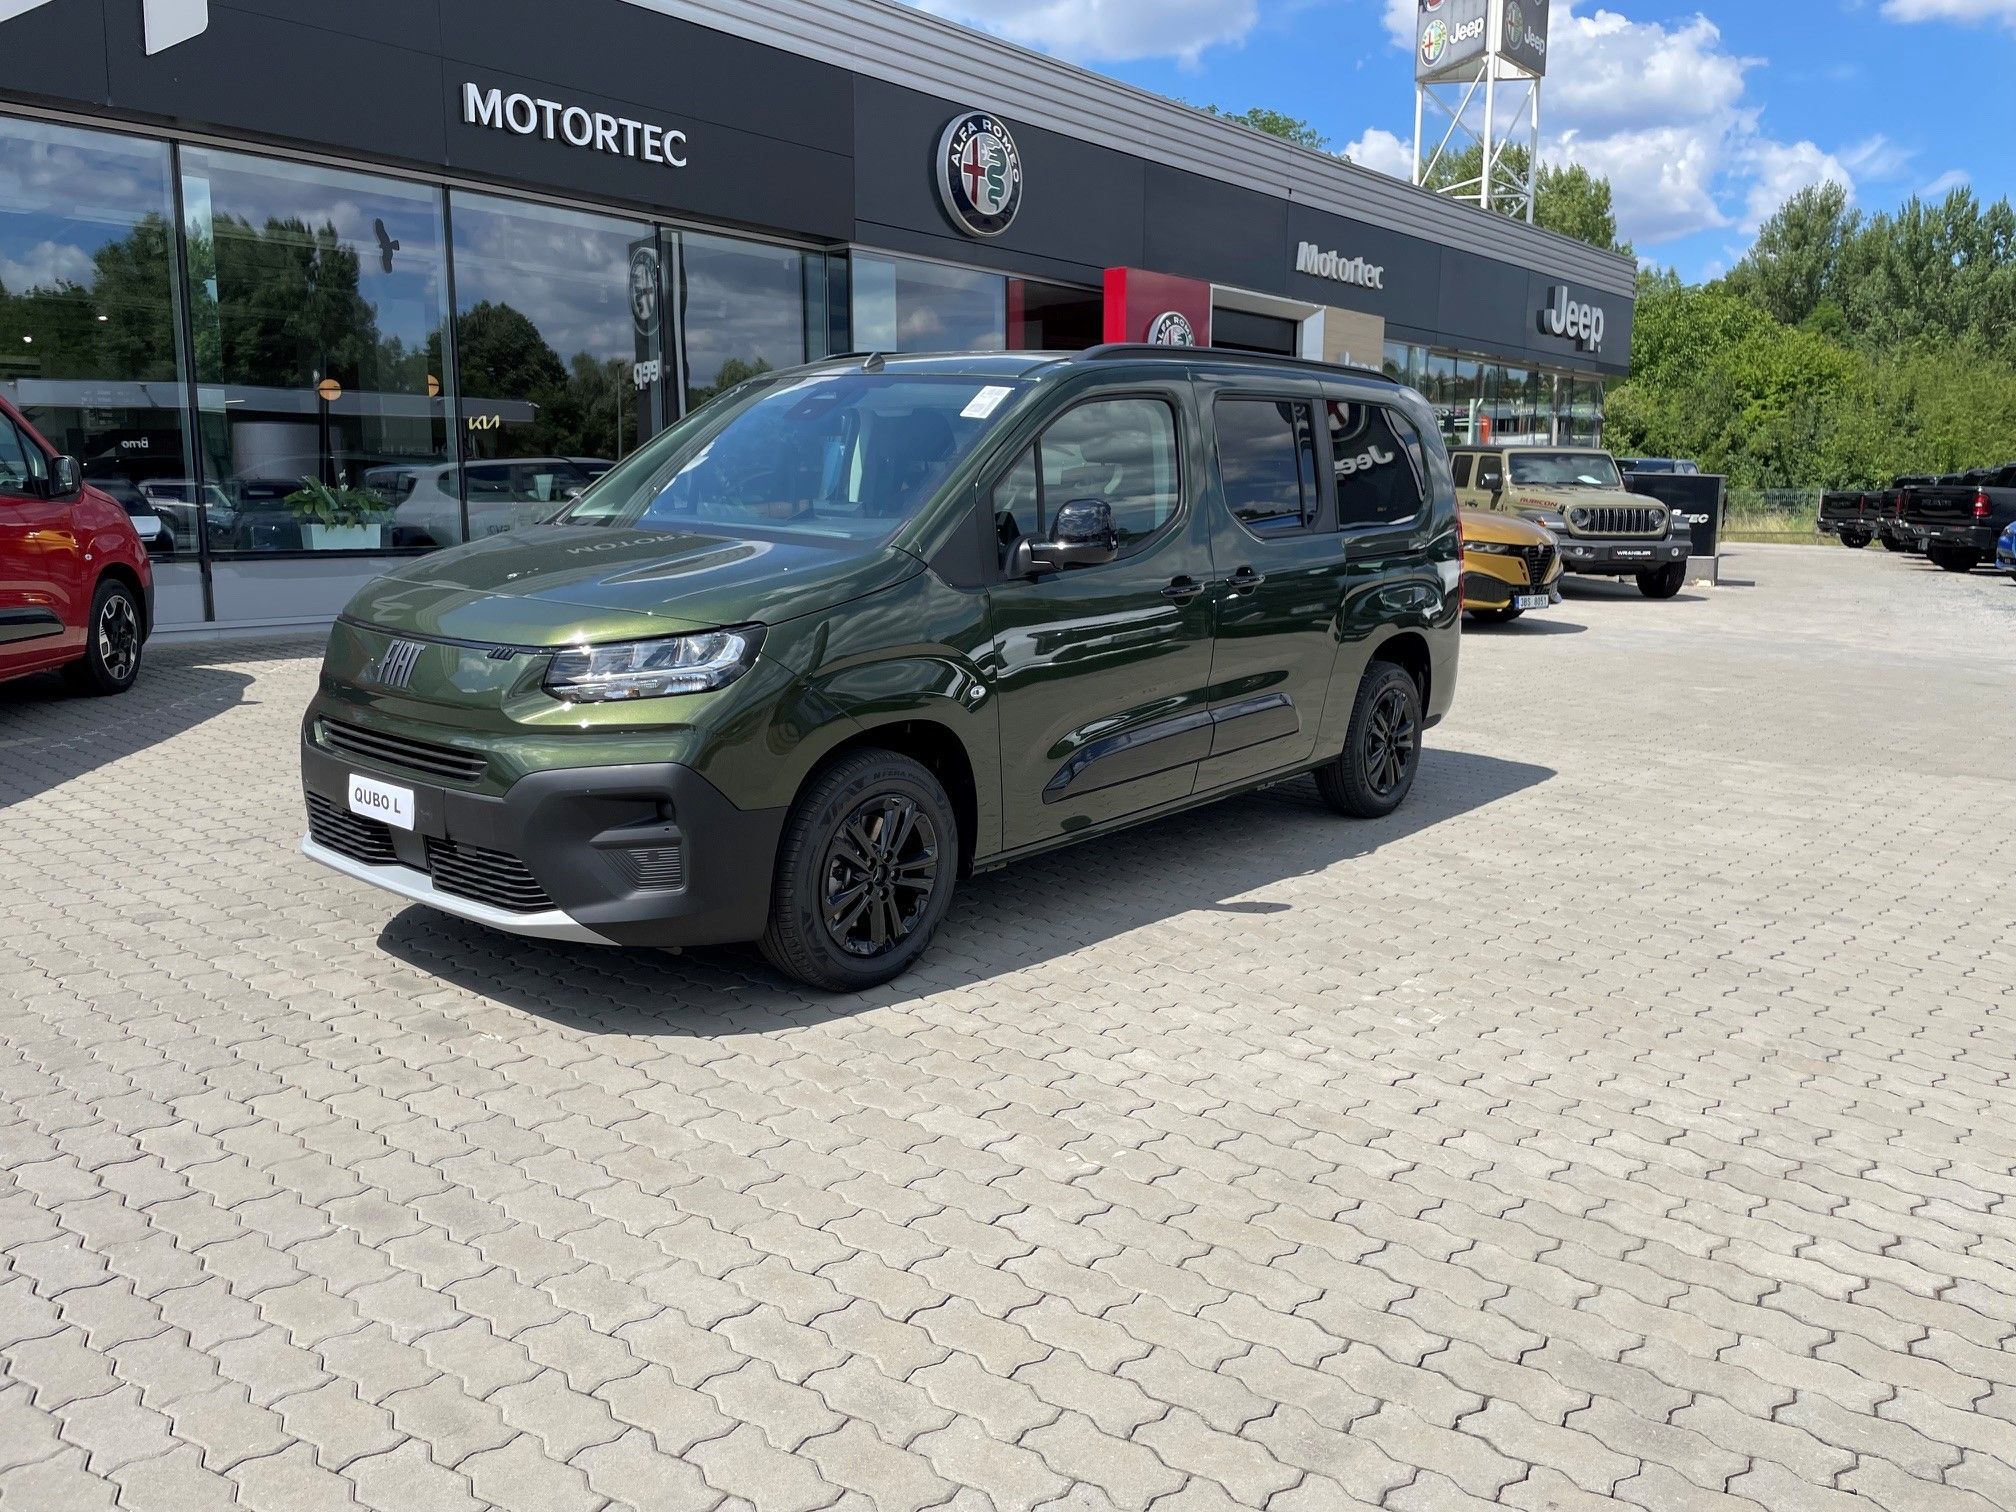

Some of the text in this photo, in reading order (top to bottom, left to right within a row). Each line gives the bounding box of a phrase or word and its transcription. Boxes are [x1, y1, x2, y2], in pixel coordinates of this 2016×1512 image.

[1450, 17, 1484, 44] Jeep
[1524, 25, 1545, 55] Jeep
[463, 82, 687, 168] MOTORTEC
[951, 119, 1019, 182] ALFA ROMEO
[1296, 241, 1384, 289] Motortec
[1547, 285, 1604, 352] Jeep
[1519, 497, 1557, 508] RUBICON
[376, 639, 427, 688] FIAT
[354, 787, 401, 814] QUBO L
